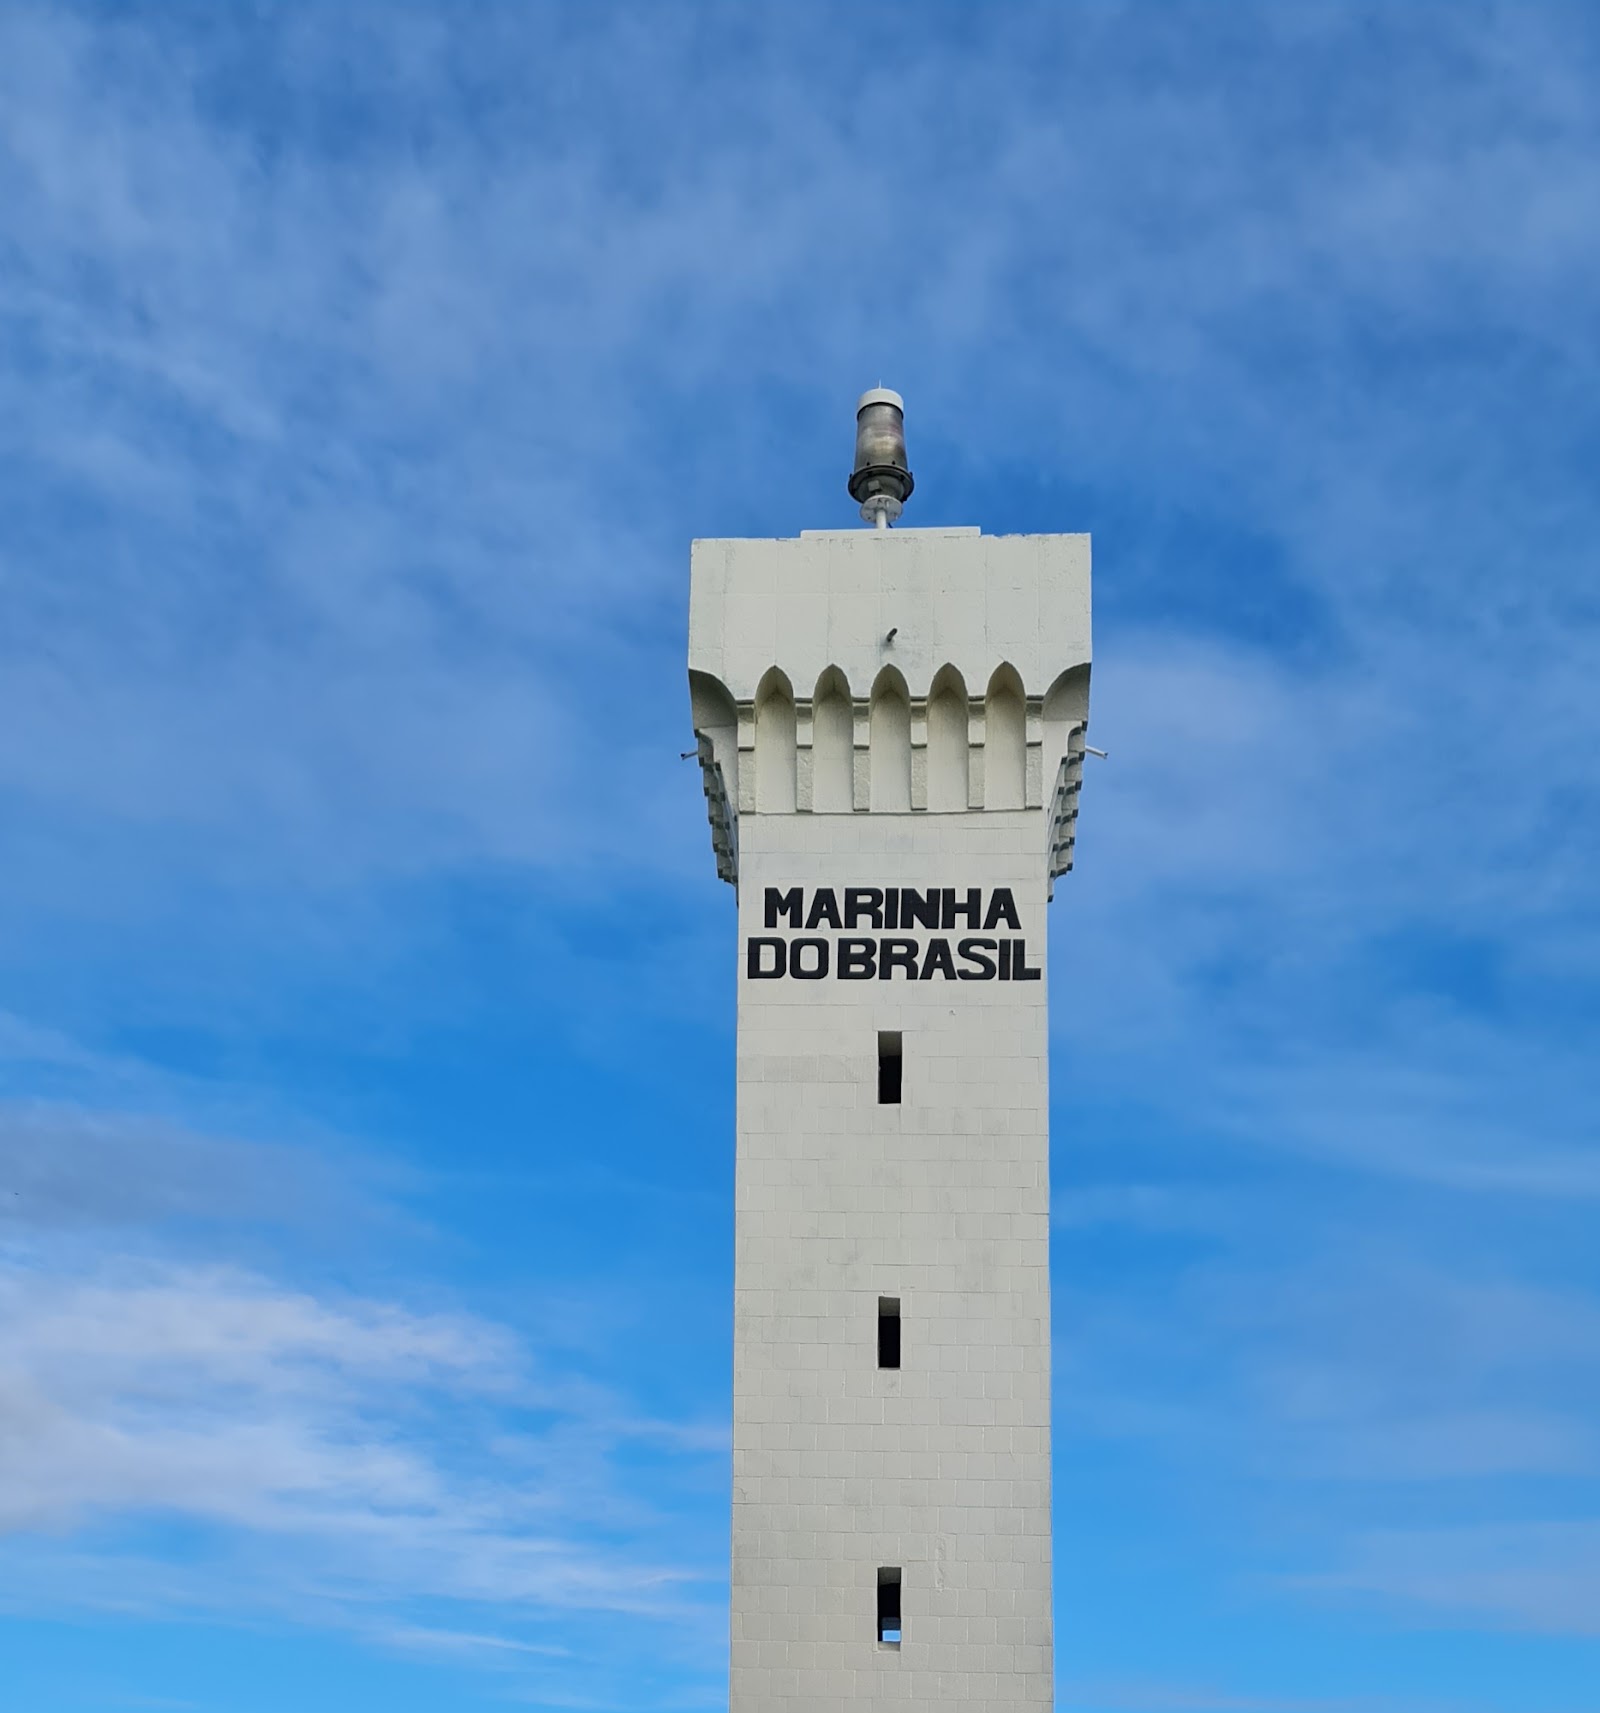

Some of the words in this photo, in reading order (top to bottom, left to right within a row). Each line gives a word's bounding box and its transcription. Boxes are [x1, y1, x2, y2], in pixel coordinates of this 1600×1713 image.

[764, 887, 1022, 930] MARINHA
[747, 936, 830, 980] DO
[836, 937, 1042, 981] BRASIL
